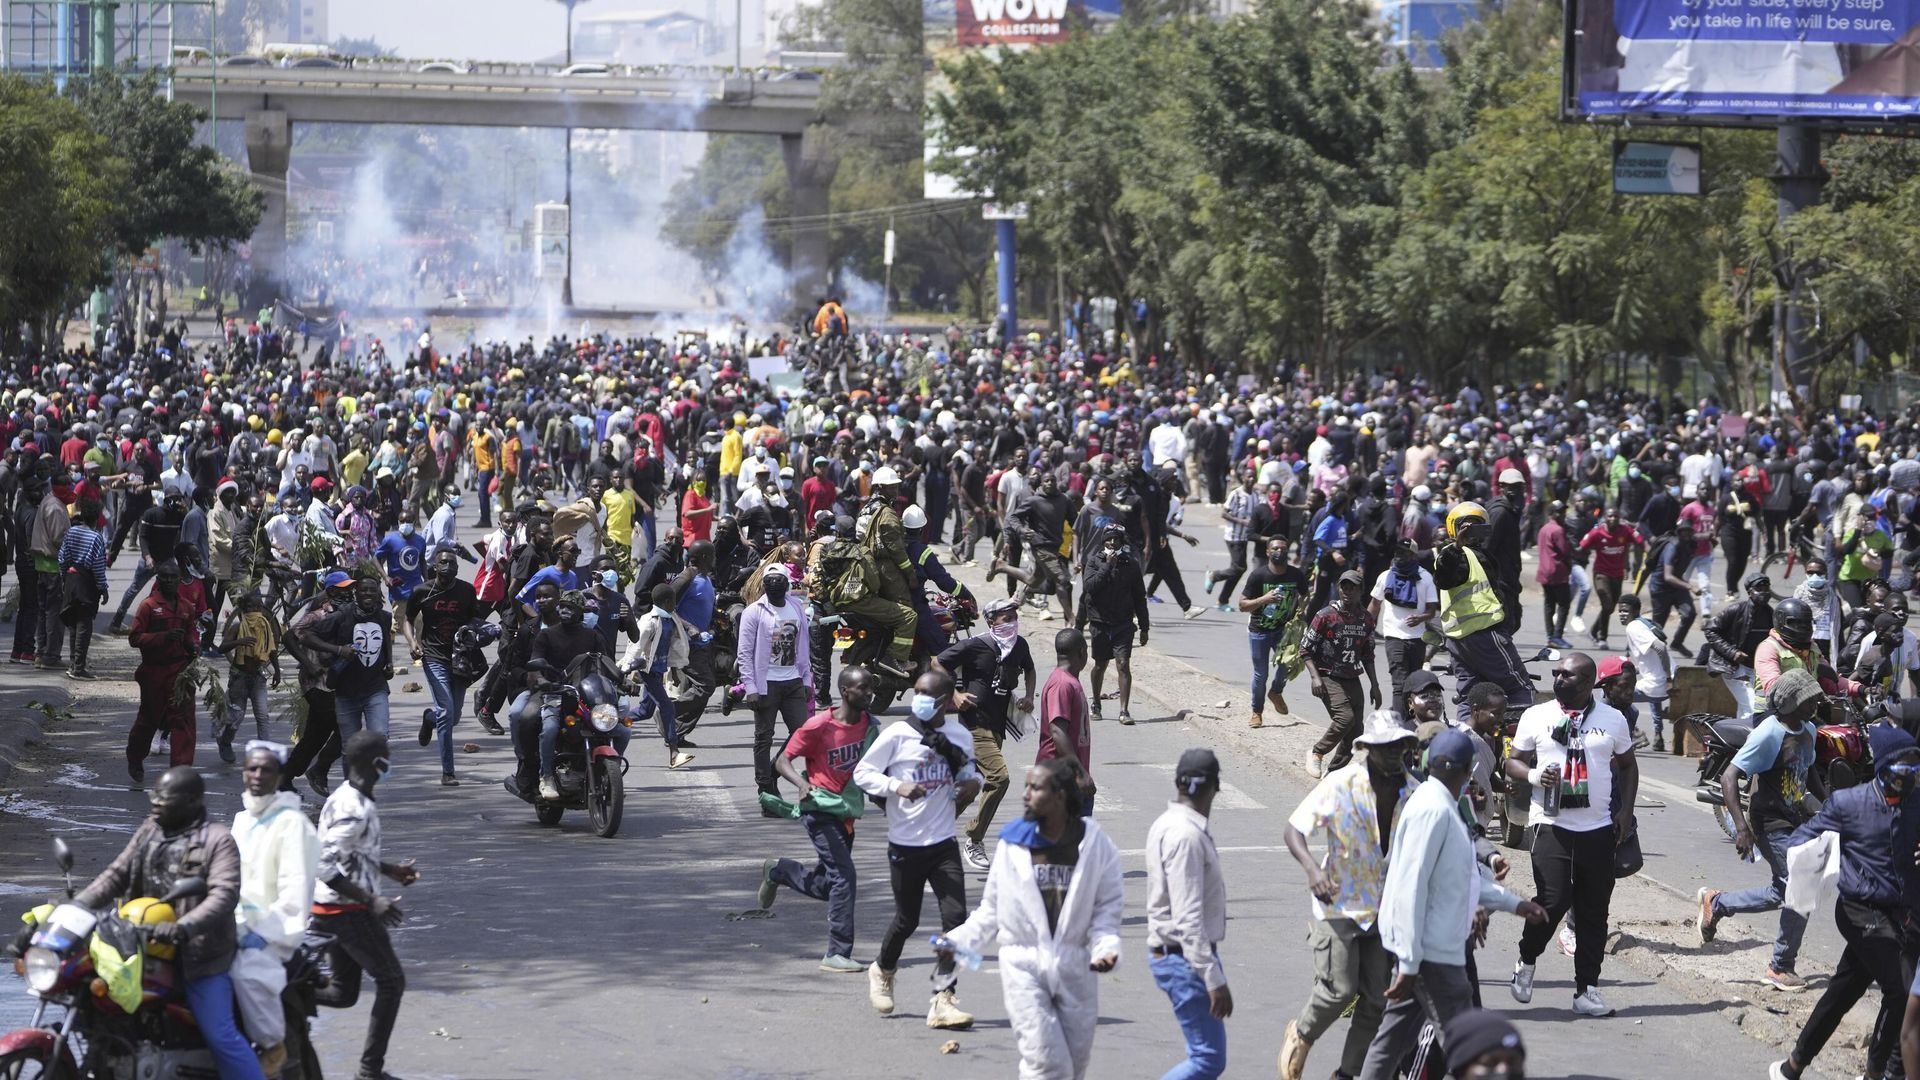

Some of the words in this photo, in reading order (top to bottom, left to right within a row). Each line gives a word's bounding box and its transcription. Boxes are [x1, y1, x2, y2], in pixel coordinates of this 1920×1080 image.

[971, 0, 1067, 21] WOW
[982, 23, 1060, 36] COLLECTION
[1668, 15, 1700, 30] you
[1704, 13, 1743, 28] take
[1745, 13, 1762, 28] in
[1765, 13, 1792, 28] life
[1795, 14, 1822, 29] will
[1826, 15, 1850, 29] be
[1853, 18, 1896, 31] sure.
